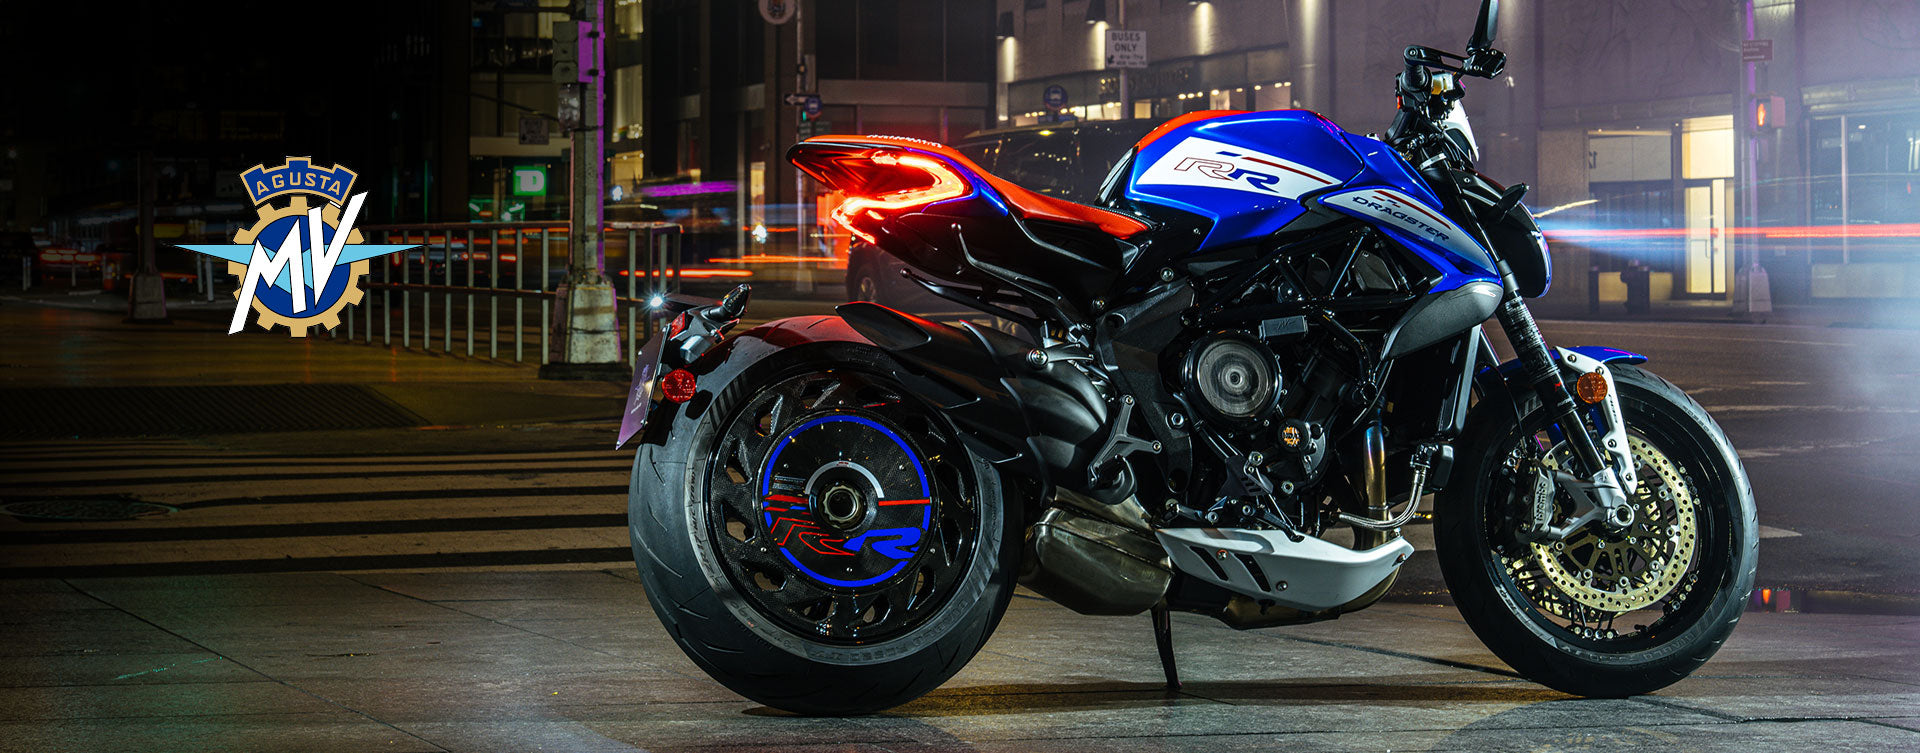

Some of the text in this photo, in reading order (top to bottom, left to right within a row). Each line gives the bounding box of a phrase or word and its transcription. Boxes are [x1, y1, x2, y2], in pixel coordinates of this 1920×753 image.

[1111, 32, 1140, 41] BUSES
[1114, 43, 1137, 52] ONLY
[515, 170, 544, 192] TD
[1173, 156, 1280, 193] RR
[1352, 195, 1450, 241] DRAGSTER
[1535, 482, 1546, 521] brembo
